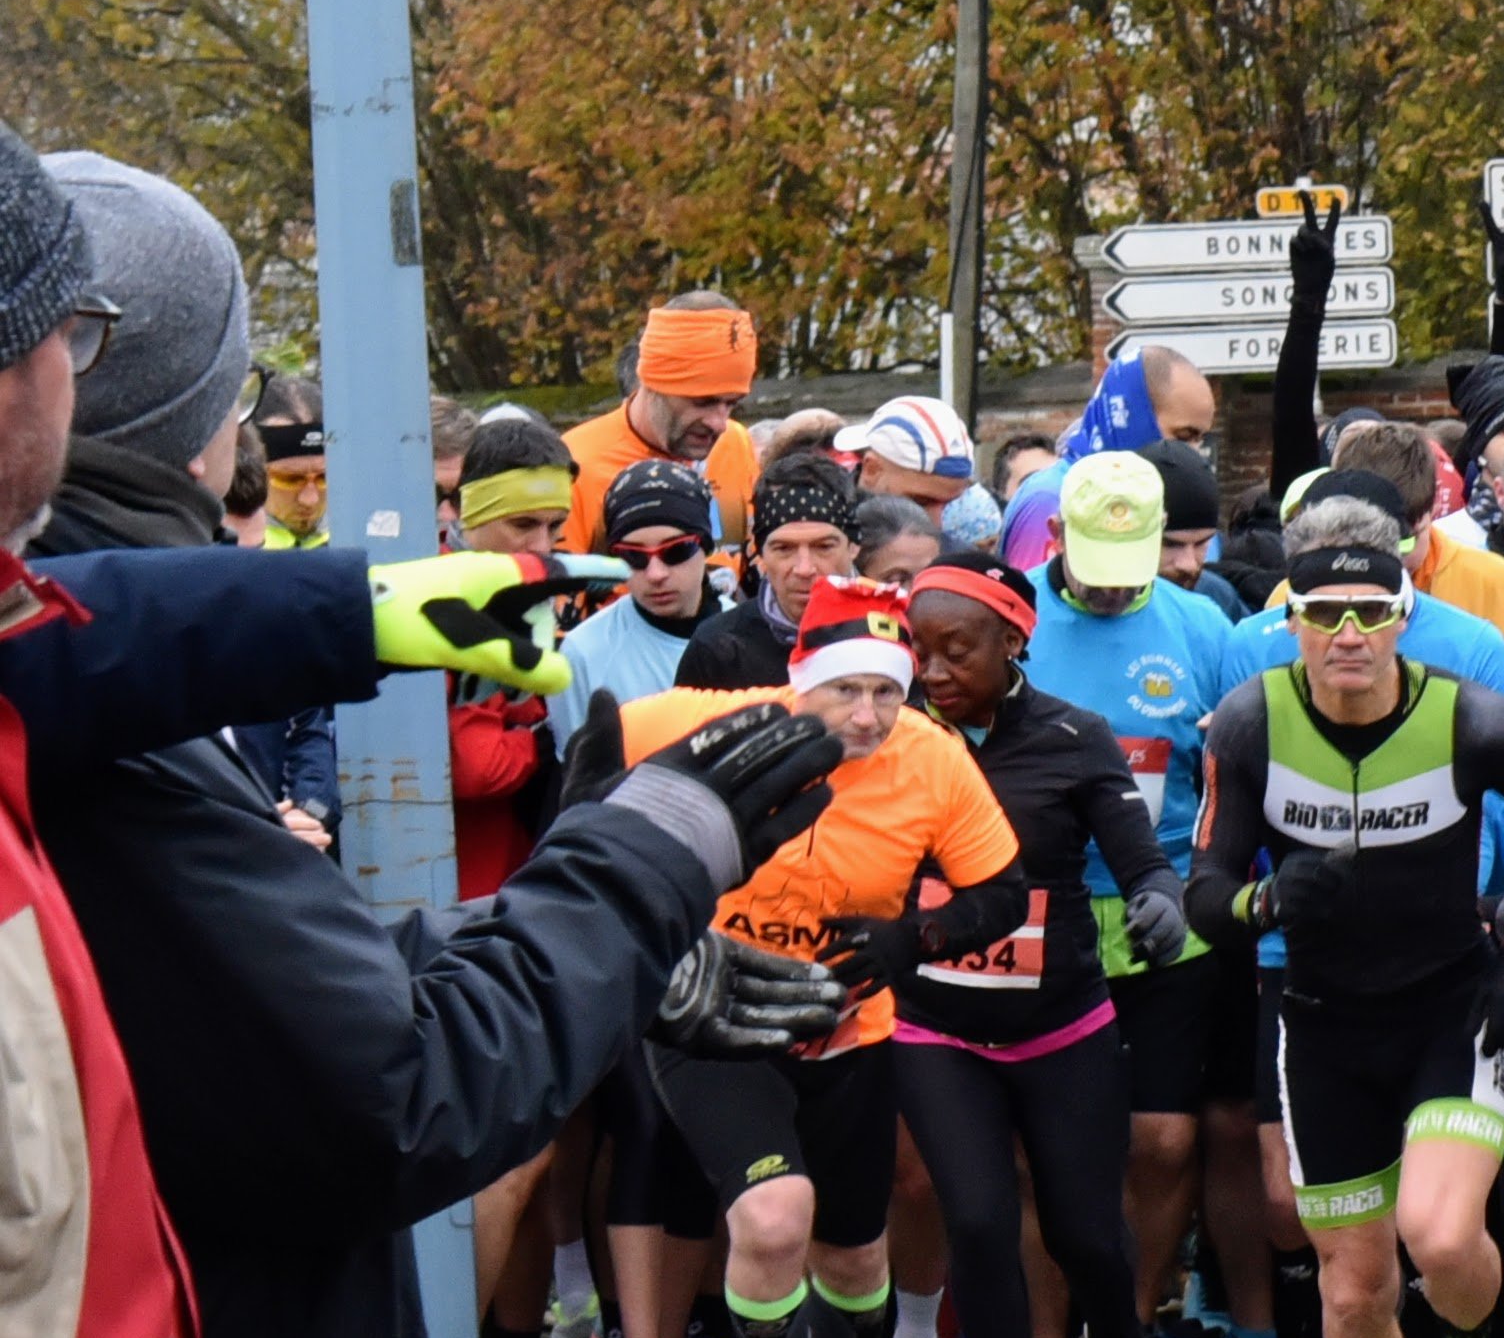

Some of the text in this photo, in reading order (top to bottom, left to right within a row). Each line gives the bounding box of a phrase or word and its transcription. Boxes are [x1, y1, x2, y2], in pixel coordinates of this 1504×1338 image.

[1267, 194, 1280, 211] D
[1229, 333, 1383, 359] FORERIE
[1359, 801, 1430, 830] RACER
[948, 941, 1017, 973] 34
